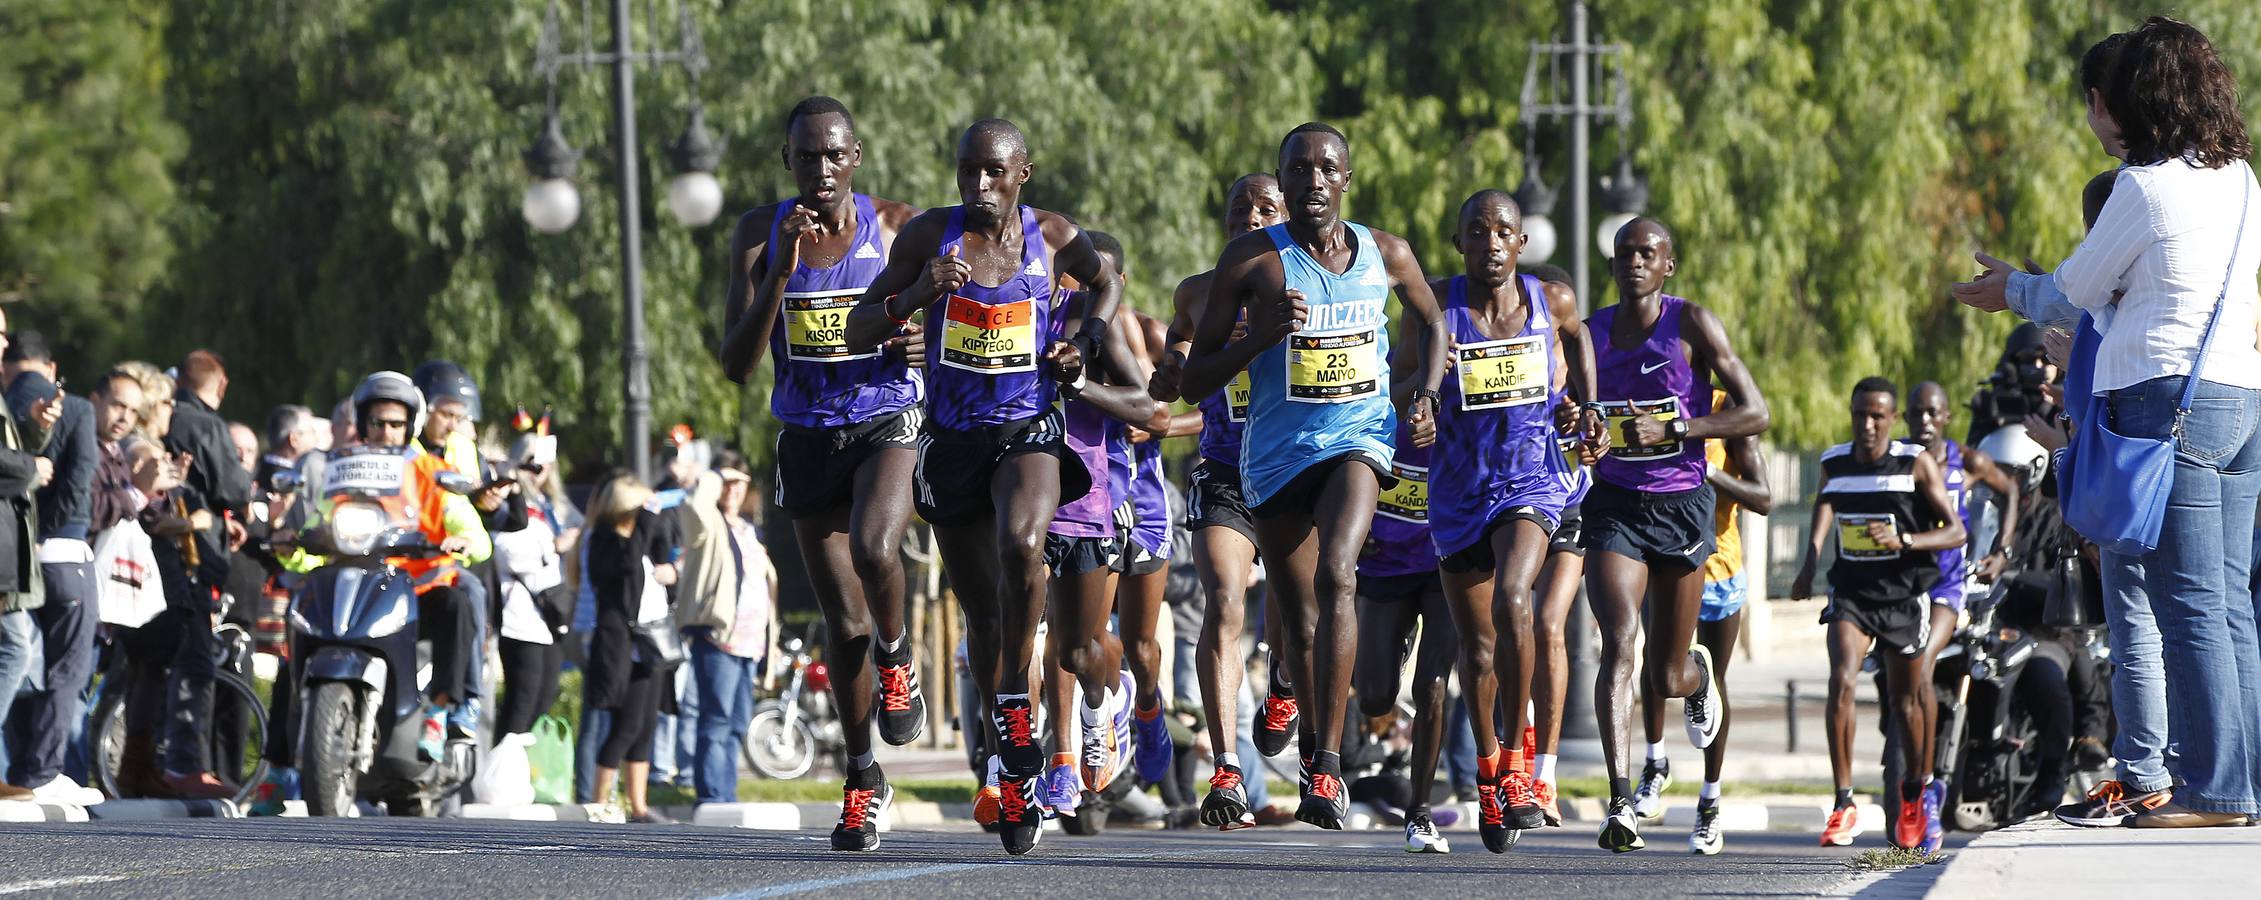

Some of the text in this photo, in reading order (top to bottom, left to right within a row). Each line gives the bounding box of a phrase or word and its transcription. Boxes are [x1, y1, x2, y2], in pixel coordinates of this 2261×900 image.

[820, 313, 840, 328] 12
[965, 308, 1013, 325] PACE
[979, 328, 1000, 340] 20
[961, 337, 1014, 353] KIPYEGO
[1326, 353, 1348, 369] 23
[1496, 361, 1514, 374] 15
[1316, 368, 1356, 382] MAIYO
[1409, 485, 1418, 497] 2
